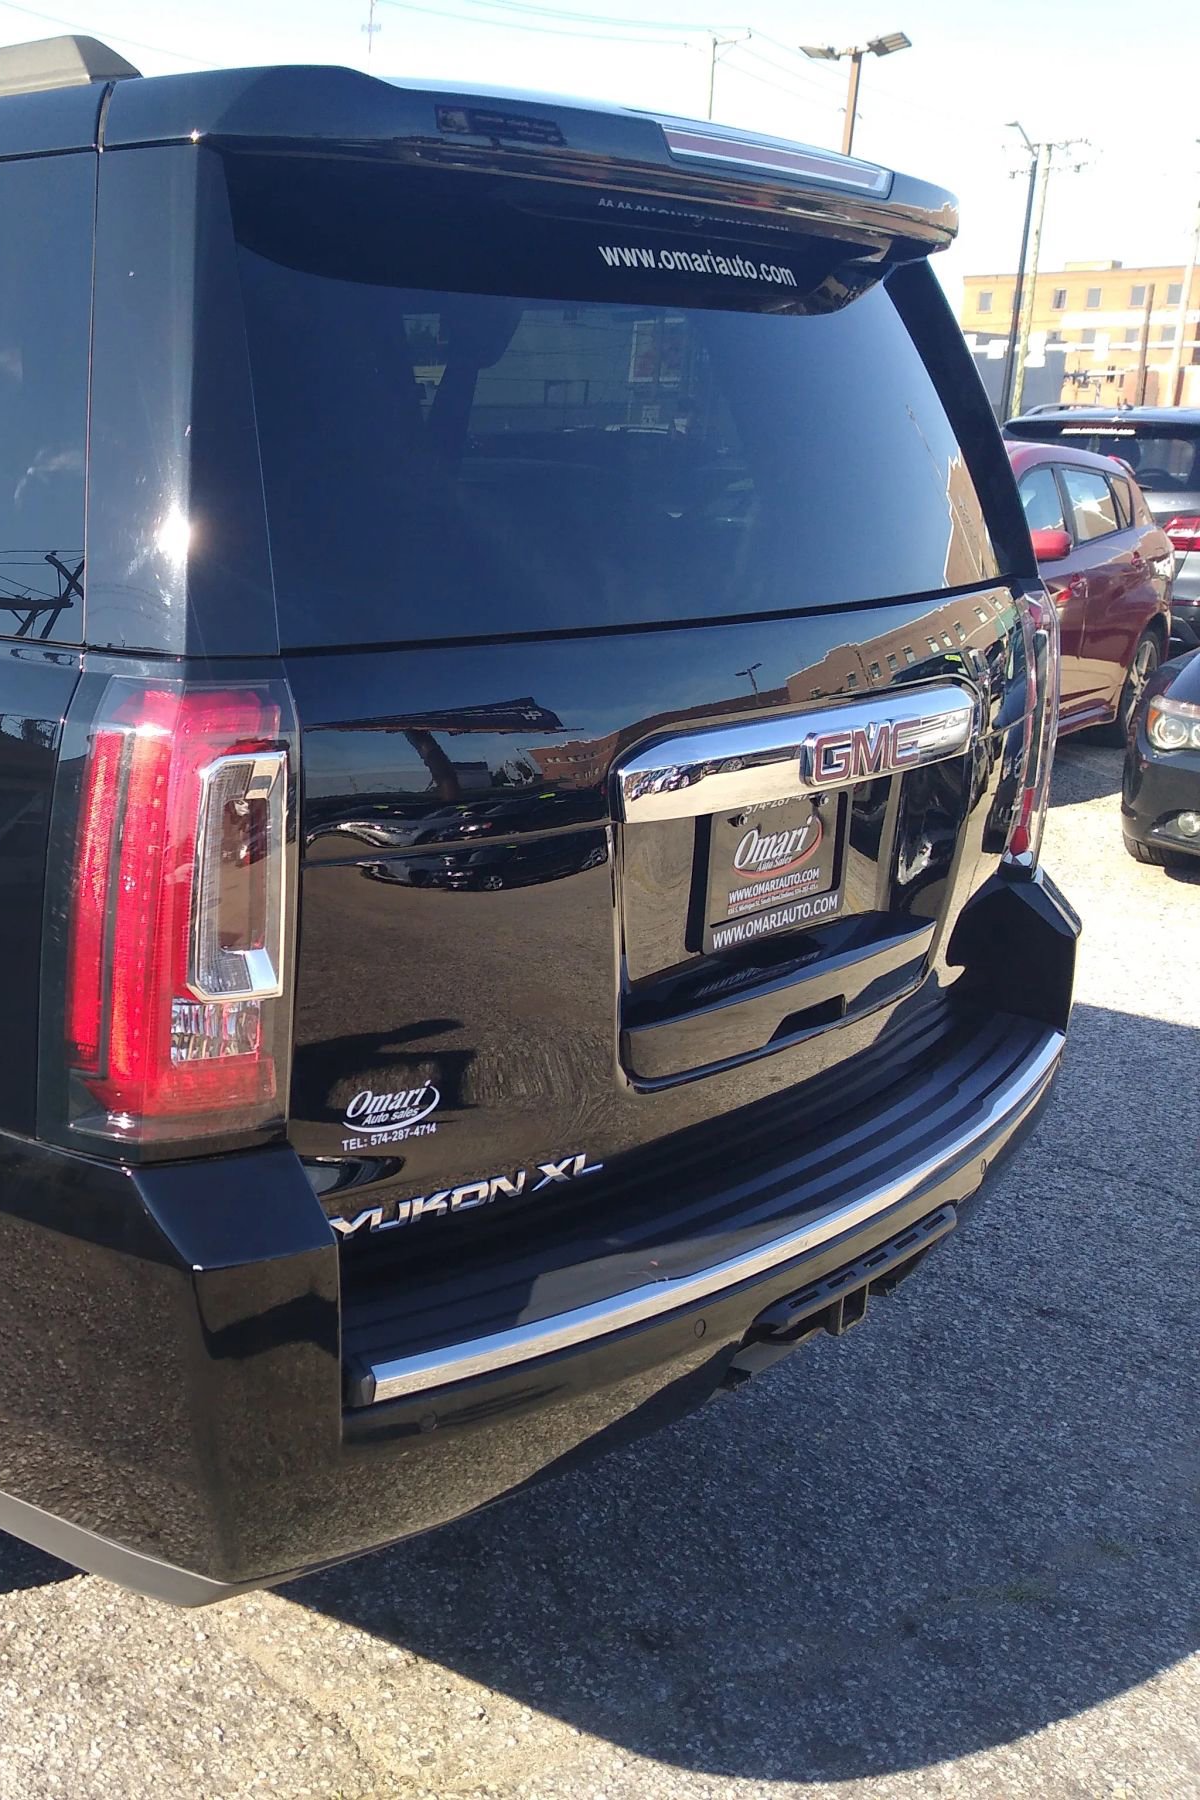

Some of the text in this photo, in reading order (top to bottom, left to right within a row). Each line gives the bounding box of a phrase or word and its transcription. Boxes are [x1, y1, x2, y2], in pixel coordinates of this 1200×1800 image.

[598, 246, 798, 287] www.omariauto.com
[810, 718, 922, 787] GMC
[734, 815, 813, 869] Omari
[728, 868, 820, 904] WWW.OMARIAUTO.COM
[712, 894, 839, 950] WWW.OMARIAUTO.COM
[346, 1080, 431, 1119] Omari
[361, 1107, 420, 1126] Auto sales
[342, 1122, 437, 1152] TEL: 574-287-4714
[329, 1152, 604, 1240] YUKON XL
